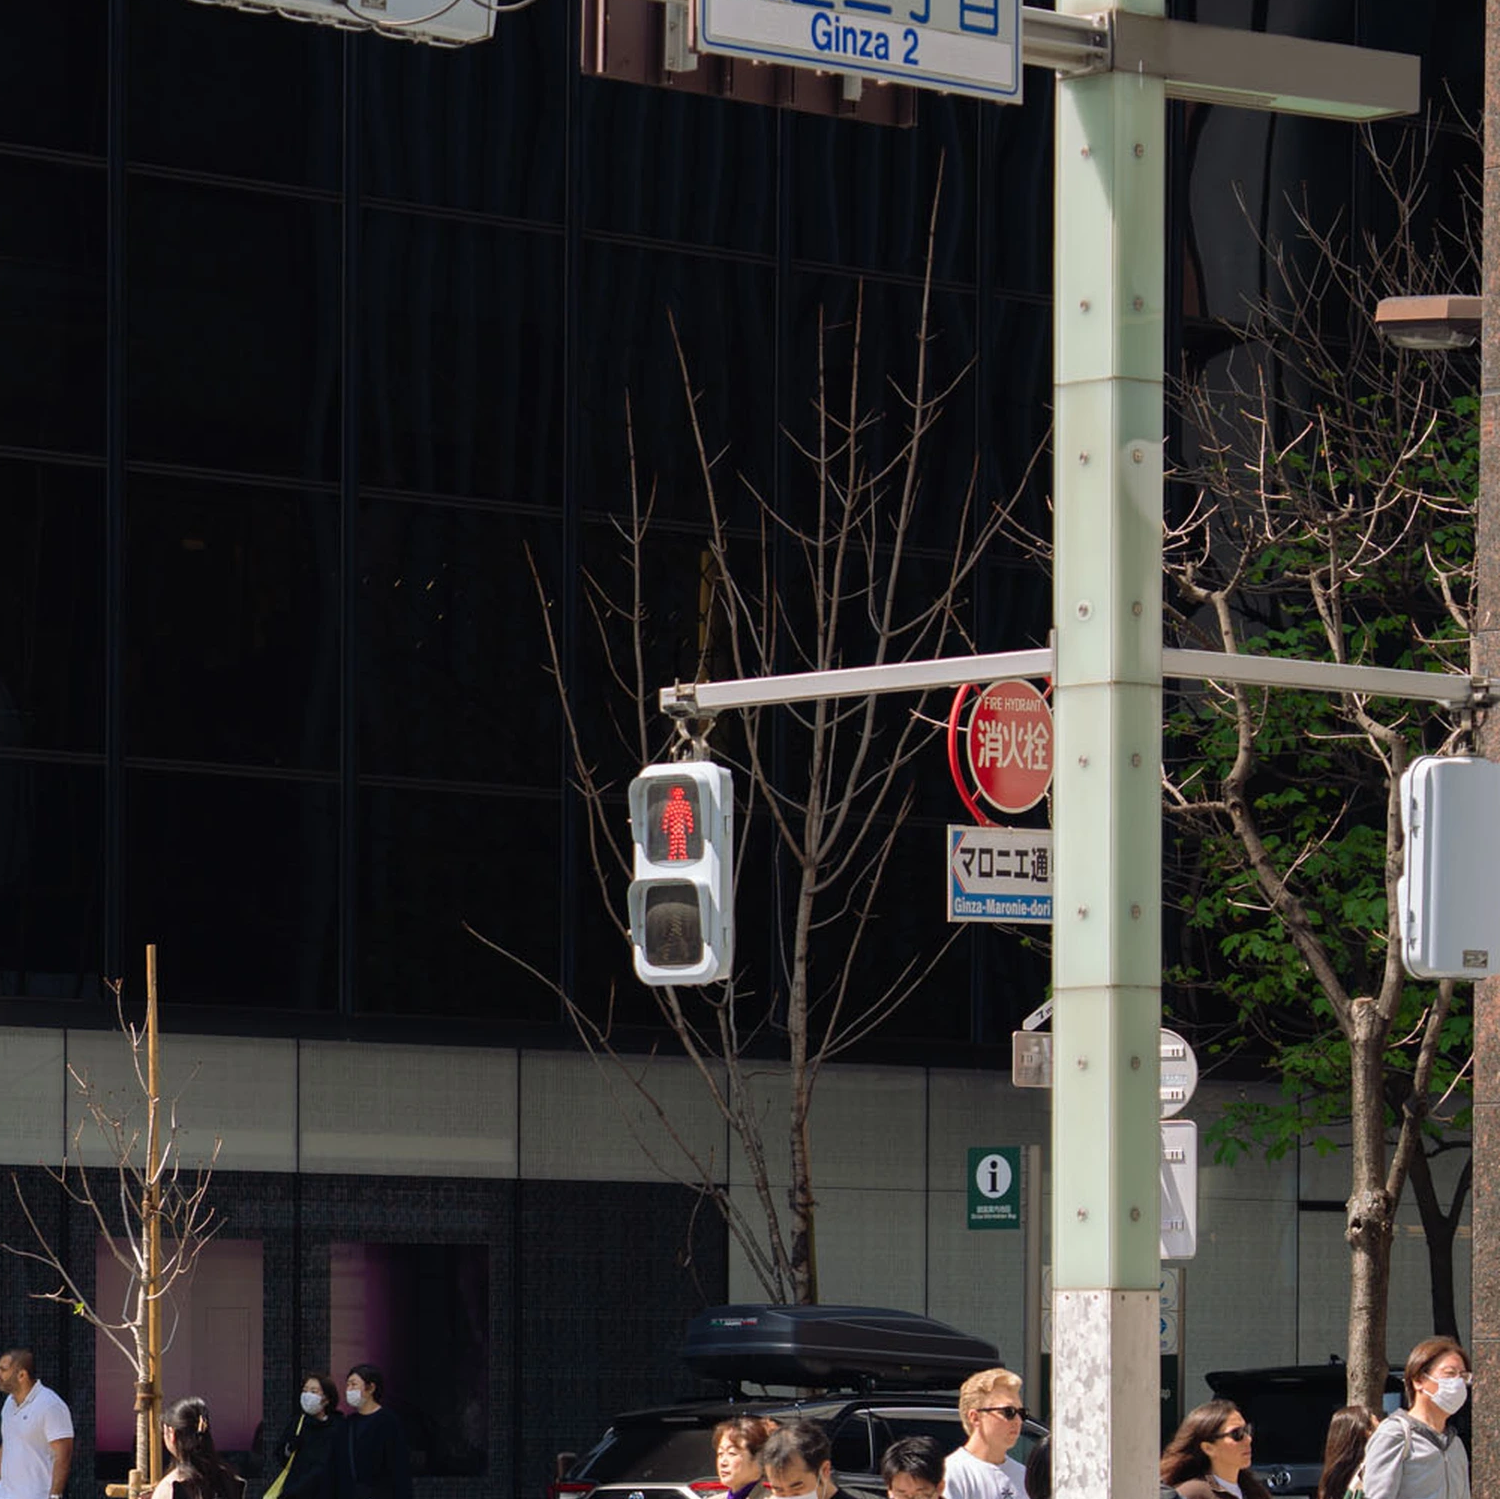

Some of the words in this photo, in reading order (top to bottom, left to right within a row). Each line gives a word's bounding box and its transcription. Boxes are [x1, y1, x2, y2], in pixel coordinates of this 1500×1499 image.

[811, 11, 890, 61] Ginza
[902, 27, 920, 66] 2
[984, 696, 1003, 710] FIRE
[1005, 698, 1041, 712] HYDRANT
[978, 719, 1050, 770] 消火栓
[955, 897, 1051, 916] Ginza-Maronie-dori
